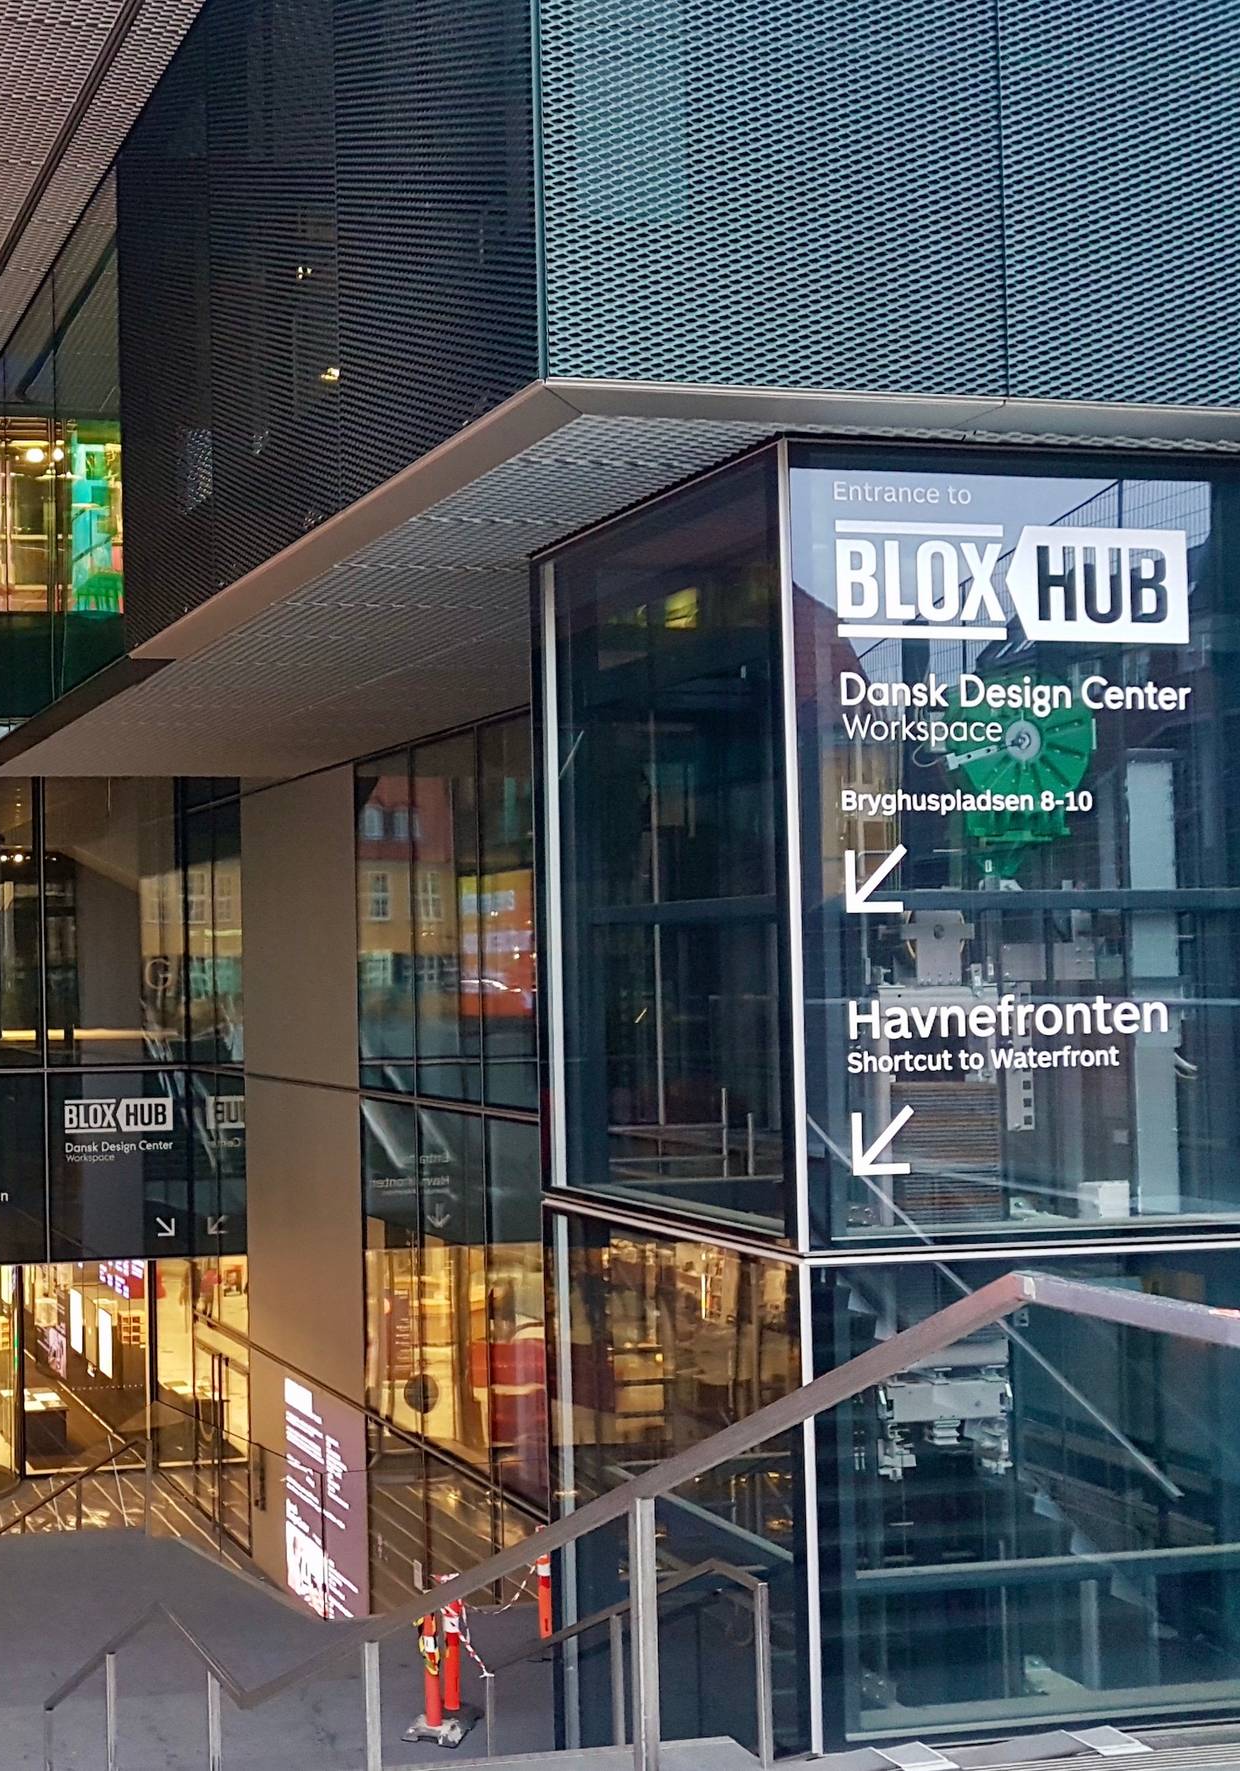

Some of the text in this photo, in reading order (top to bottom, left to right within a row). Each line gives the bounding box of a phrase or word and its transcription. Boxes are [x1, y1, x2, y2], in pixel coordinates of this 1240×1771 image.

[833, 480, 972, 504] Entrance to
[840, 671, 1192, 718] Dansk Design Center
[842, 713, 1003, 747] Workspace
[841, 789, 1094, 817] Bryghuspladsen 8-10
[848, 994, 1170, 1040] Havnefronten
[847, 1045, 1120, 1074] Shortcut to Waterfront
[65, 1140, 174, 1154] Dansk Design Center
[65, 1153, 116, 1163] Workspace
